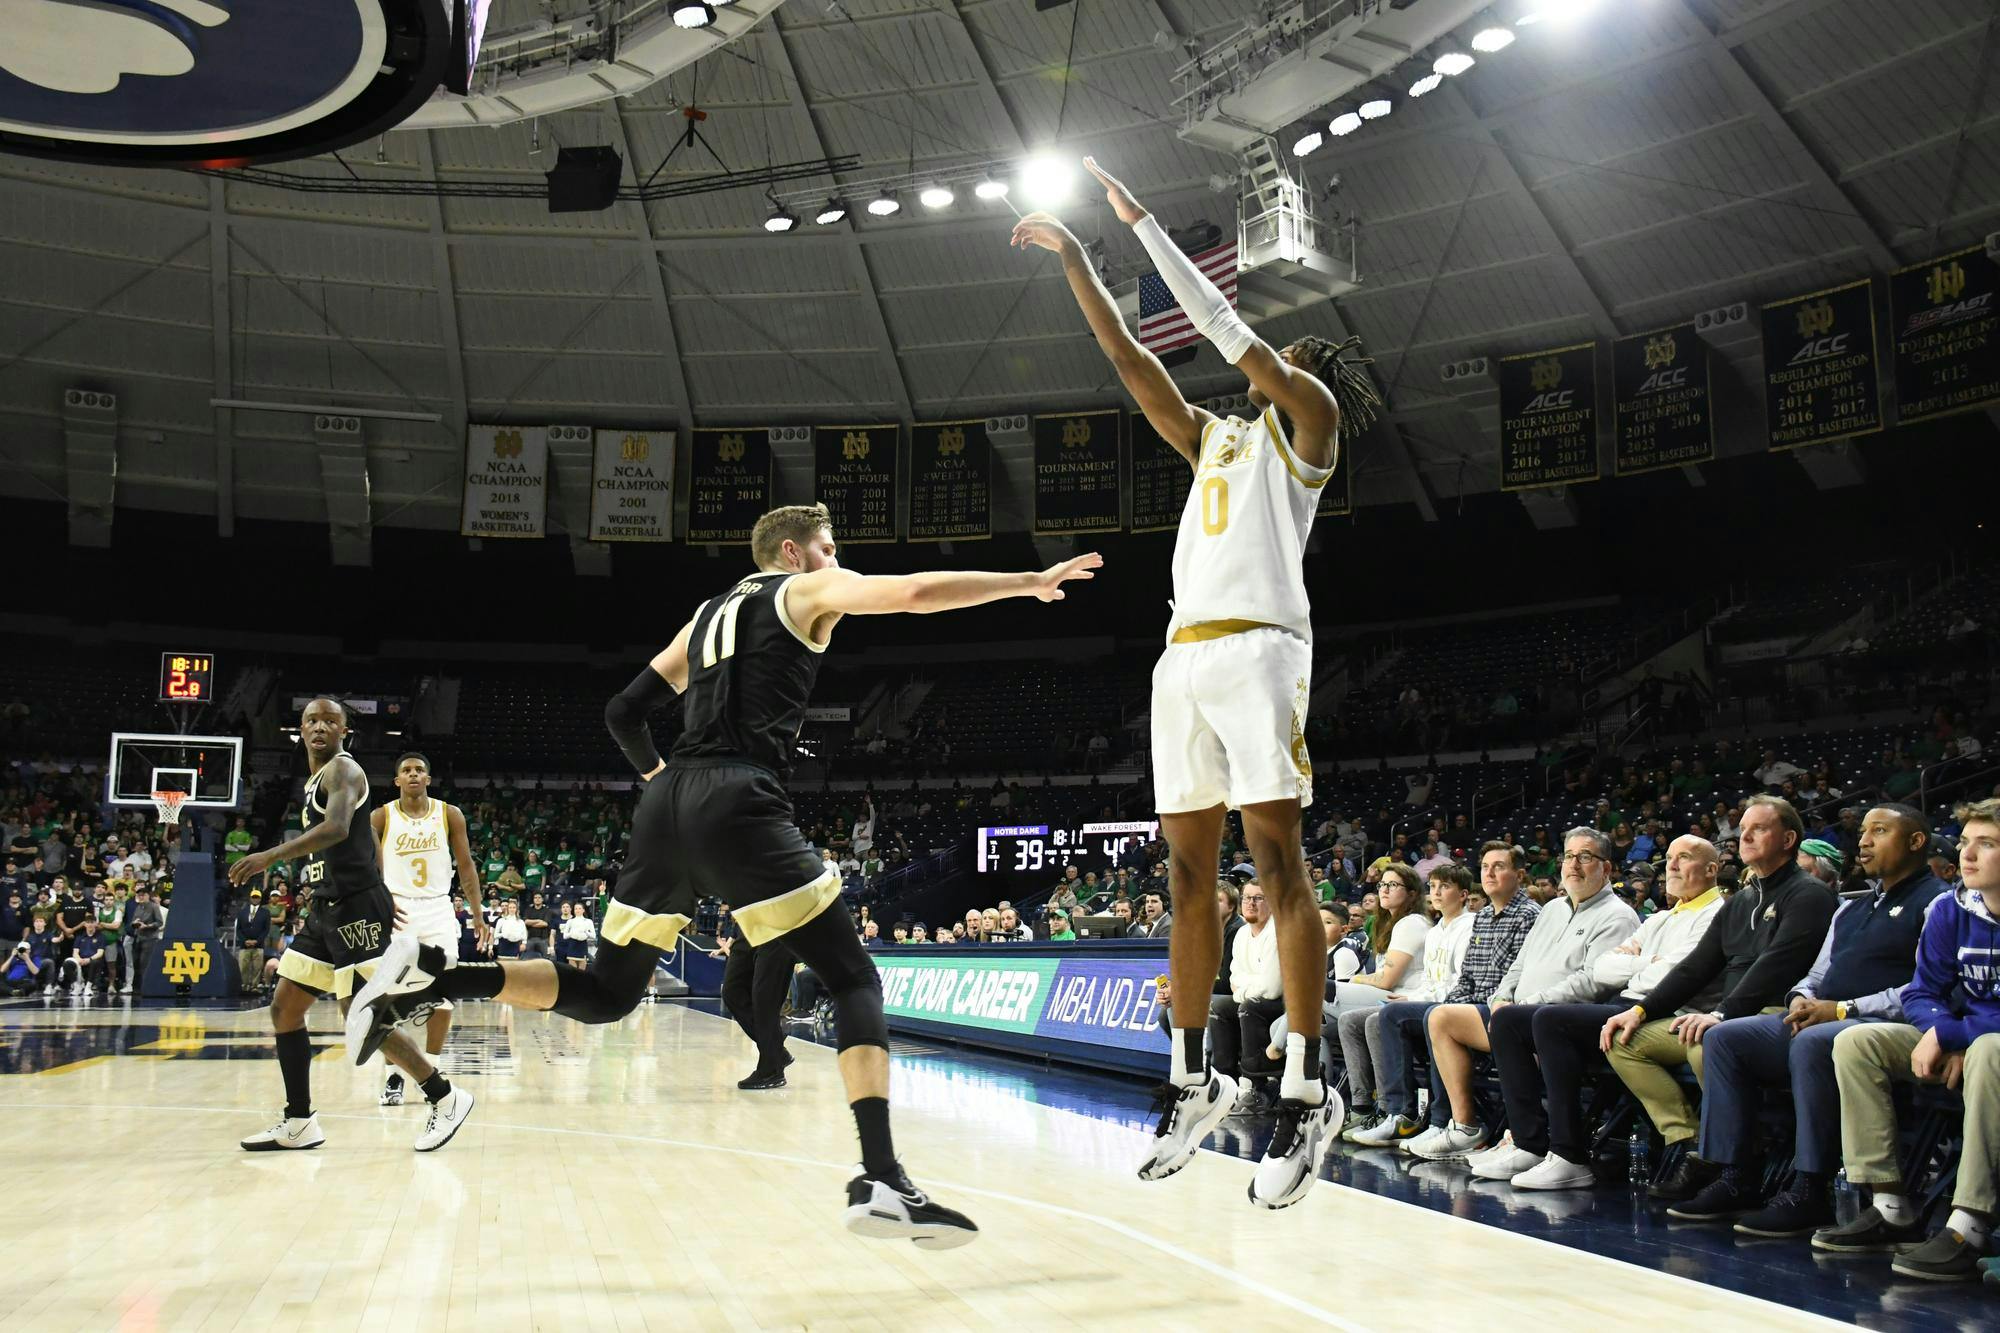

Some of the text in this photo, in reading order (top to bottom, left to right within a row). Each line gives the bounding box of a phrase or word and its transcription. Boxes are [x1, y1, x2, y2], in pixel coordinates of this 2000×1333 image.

[1791, 332, 1851, 362] ACC
[1824, 353, 1868, 373] SEASON
[1638, 366, 1688, 392] ACC
[1788, 370, 1852, 393] CHAMPION
[1525, 389, 1575, 410] ACC
[1778, 393, 1813, 410] 2014
[1504, 408, 1592, 430] TOURNAMENT
[1780, 400, 1865, 427] 2016 2017
[1515, 422, 1581, 441] CHAMPION
[1626, 422, 1655, 438] 2018
[487, 462, 526, 473] NCAA
[839, 463, 872, 473] NCAA
[936, 458, 967, 469] NCAA
[1038, 460, 1116, 474] TOURNAMENT
[1512, 455, 1541, 469] 2016
[614, 466, 654, 477] NCAA
[713, 464, 747, 474] NCAA
[469, 474, 541, 486] CHAMPION
[695, 474, 765, 486] FINAL FOUR
[820, 473, 890, 484] FINAL FOUR
[597, 479, 669, 491] CHAMPION
[490, 492, 521, 503] 2018
[736, 489, 762, 500] 2018
[823, 488, 887, 499] 1997 2001
[620, 497, 647, 508] 2001
[697, 503, 723, 514] 2019
[862, 500, 887, 512] 2012
[1203, 476, 1228, 536] 0
[480, 510, 529, 520] WOMEN'S
[608, 514, 656, 525] WOMEN'S
[862, 514, 887, 525] 2014
[471, 521, 536, 533] BASKETBALL
[1037, 518, 1071, 529] WOMEN'S
[599, 526, 663, 537] BASKETBALL
[702, 593, 746, 669] 11
[172, 657, 208, 671] 18:11
[994, 827, 1040, 836] NOTRE DAME
[1053, 829, 1083, 846] 18:11
[395, 831, 440, 854] Irish
[1014, 839, 1044, 870] 39
[410, 858, 428, 887] 3
[338, 919, 382, 951] WF
[906, 967, 958, 1012] YOUR
[952, 968, 1039, 1022] CAREER
